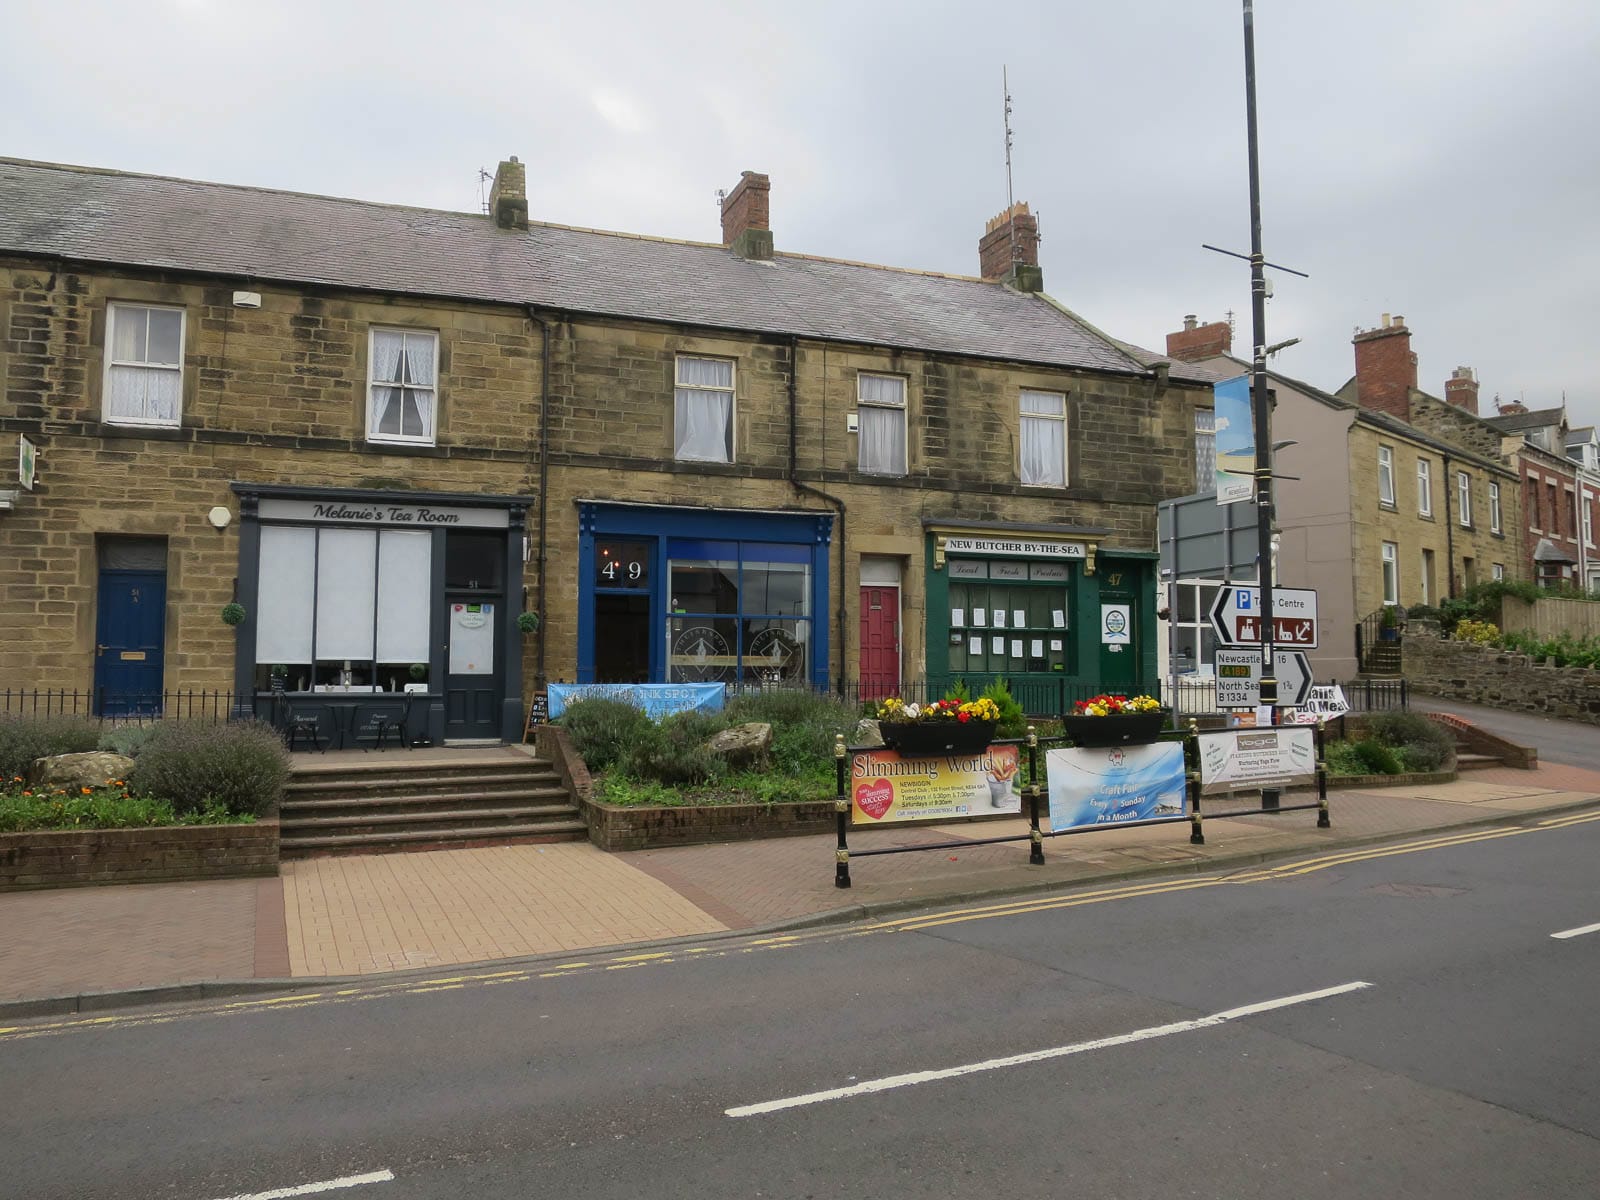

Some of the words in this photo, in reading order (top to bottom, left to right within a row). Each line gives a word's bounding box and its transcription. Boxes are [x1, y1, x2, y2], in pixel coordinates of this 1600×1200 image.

[313, 504, 383, 521] Melanie's
[387, 507, 413, 521] Tea
[416, 508, 460, 523] Room
[950, 540, 973, 550] NEW
[975, 541, 1023, 552] BUTCHER
[1024, 543, 1080, 555] BY-THE-SEA
[468, 580, 479, 589] 51
[1107, 574, 1122, 586] 47
[1278, 598, 1305, 608] Centre
[1218, 654, 1261, 664] Newcastle
[1277, 655, 1287, 664] 16
[1218, 680, 1242, 691] North
[854, 754, 939, 780] Slimming
[945, 751, 994, 773] World
[1100, 784, 1121, 795] Craft
[1122, 783, 1138, 793] Fair
[1120, 795, 1146, 808] Sunday
[1112, 810, 1138, 821] Month
